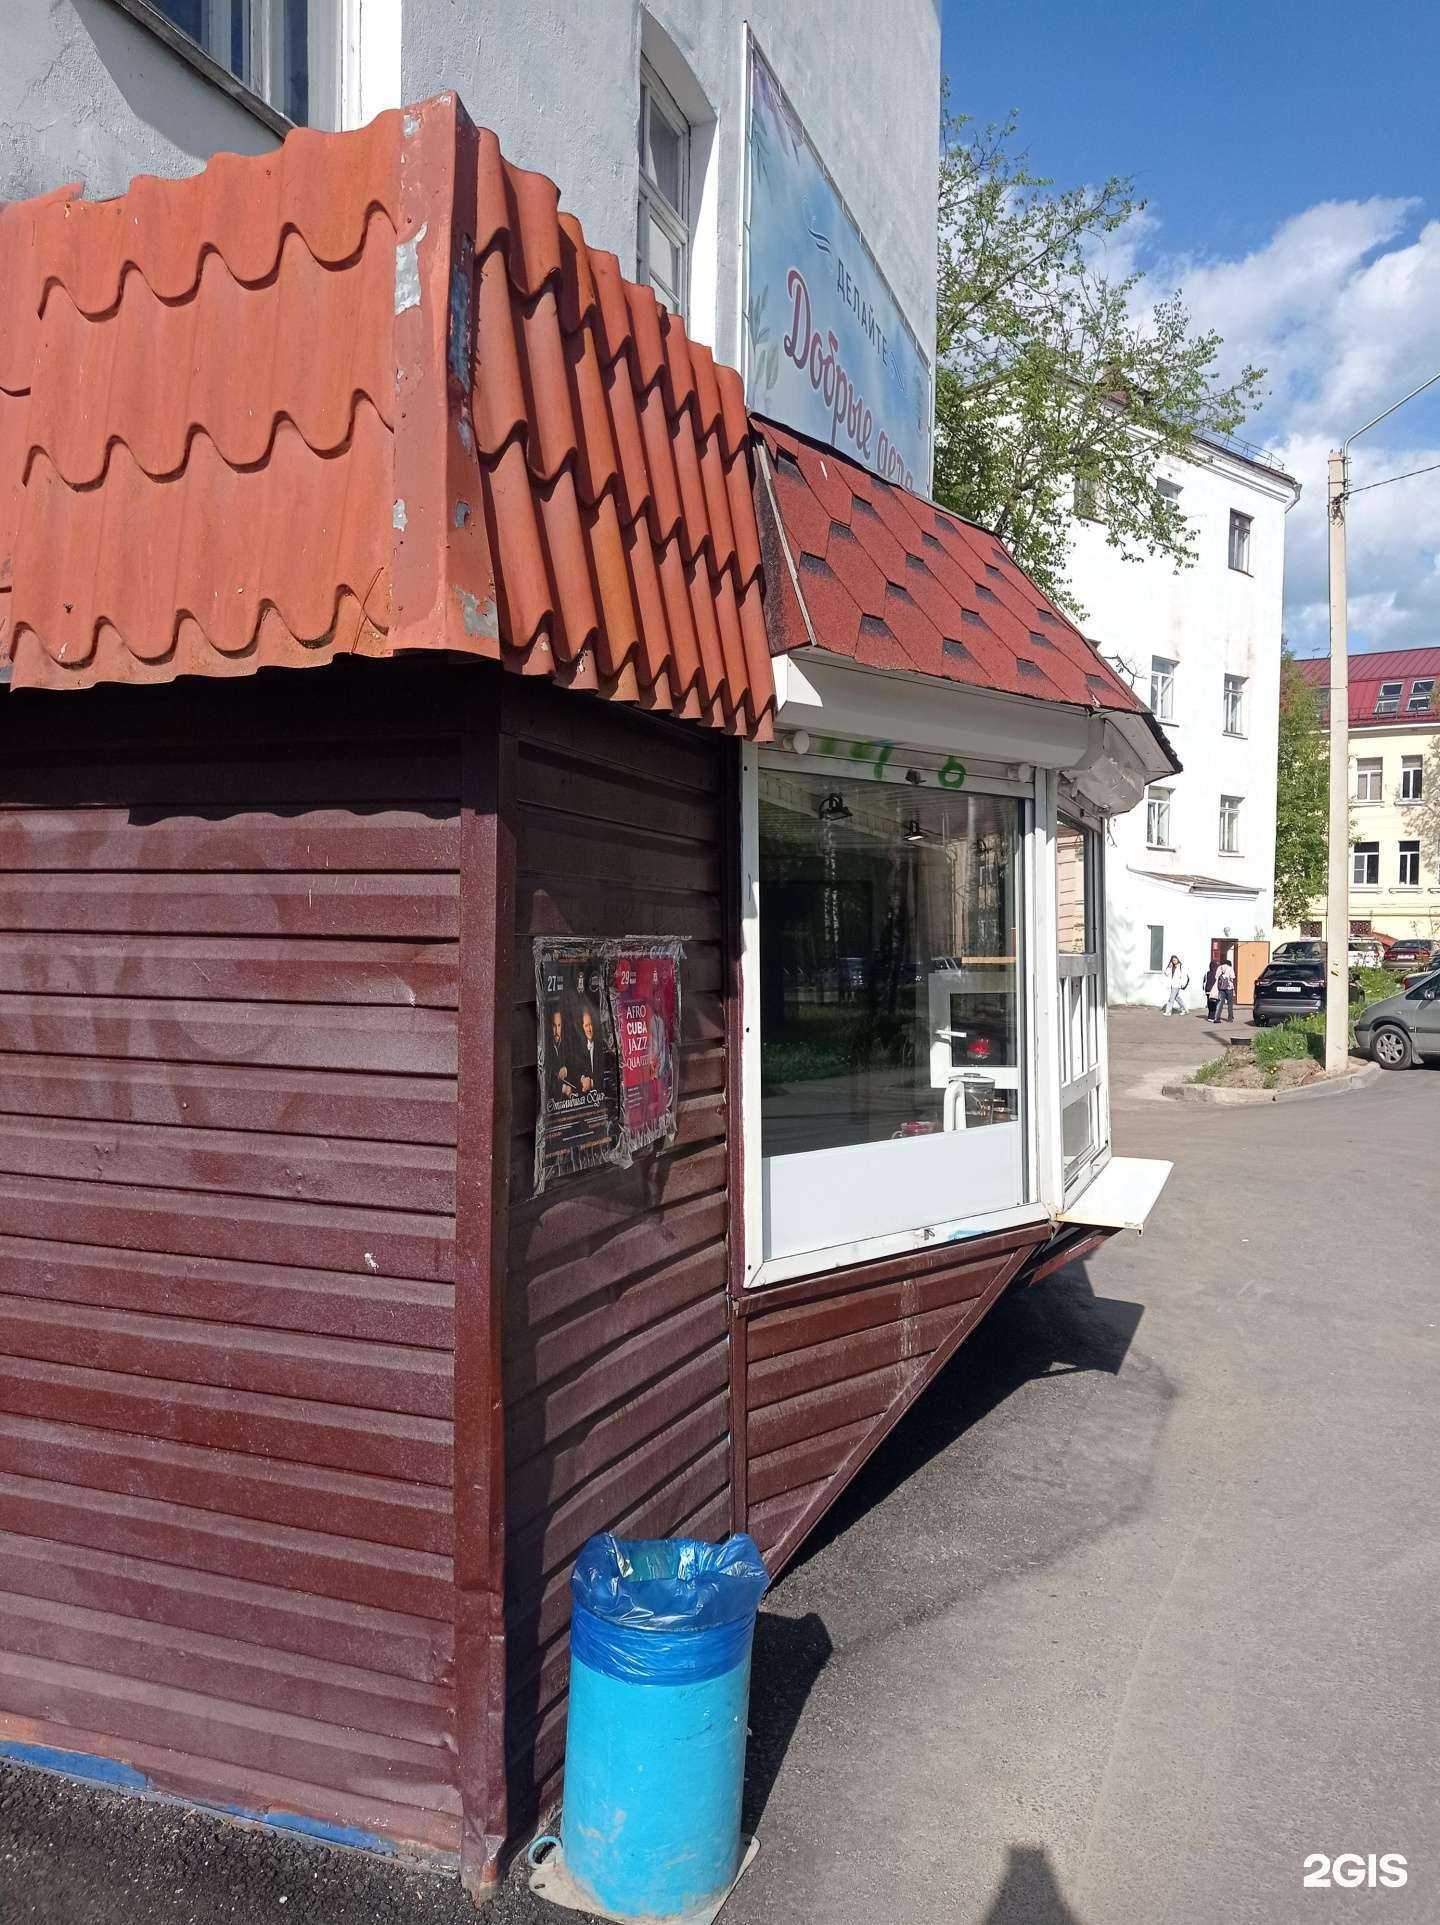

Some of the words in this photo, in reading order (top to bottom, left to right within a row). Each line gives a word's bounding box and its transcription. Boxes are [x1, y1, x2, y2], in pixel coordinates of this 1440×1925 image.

[837, 258, 888, 367] ДЕЛАЙТЕ
[784, 268, 873, 461] Добрые
[547, 975, 557, 992] 27
[621, 971, 630, 985] 29
[626, 1004, 647, 1020] AFRO
[626, 1021, 648, 1037] CUBA
[628, 1036, 648, 1055] JAZZ
